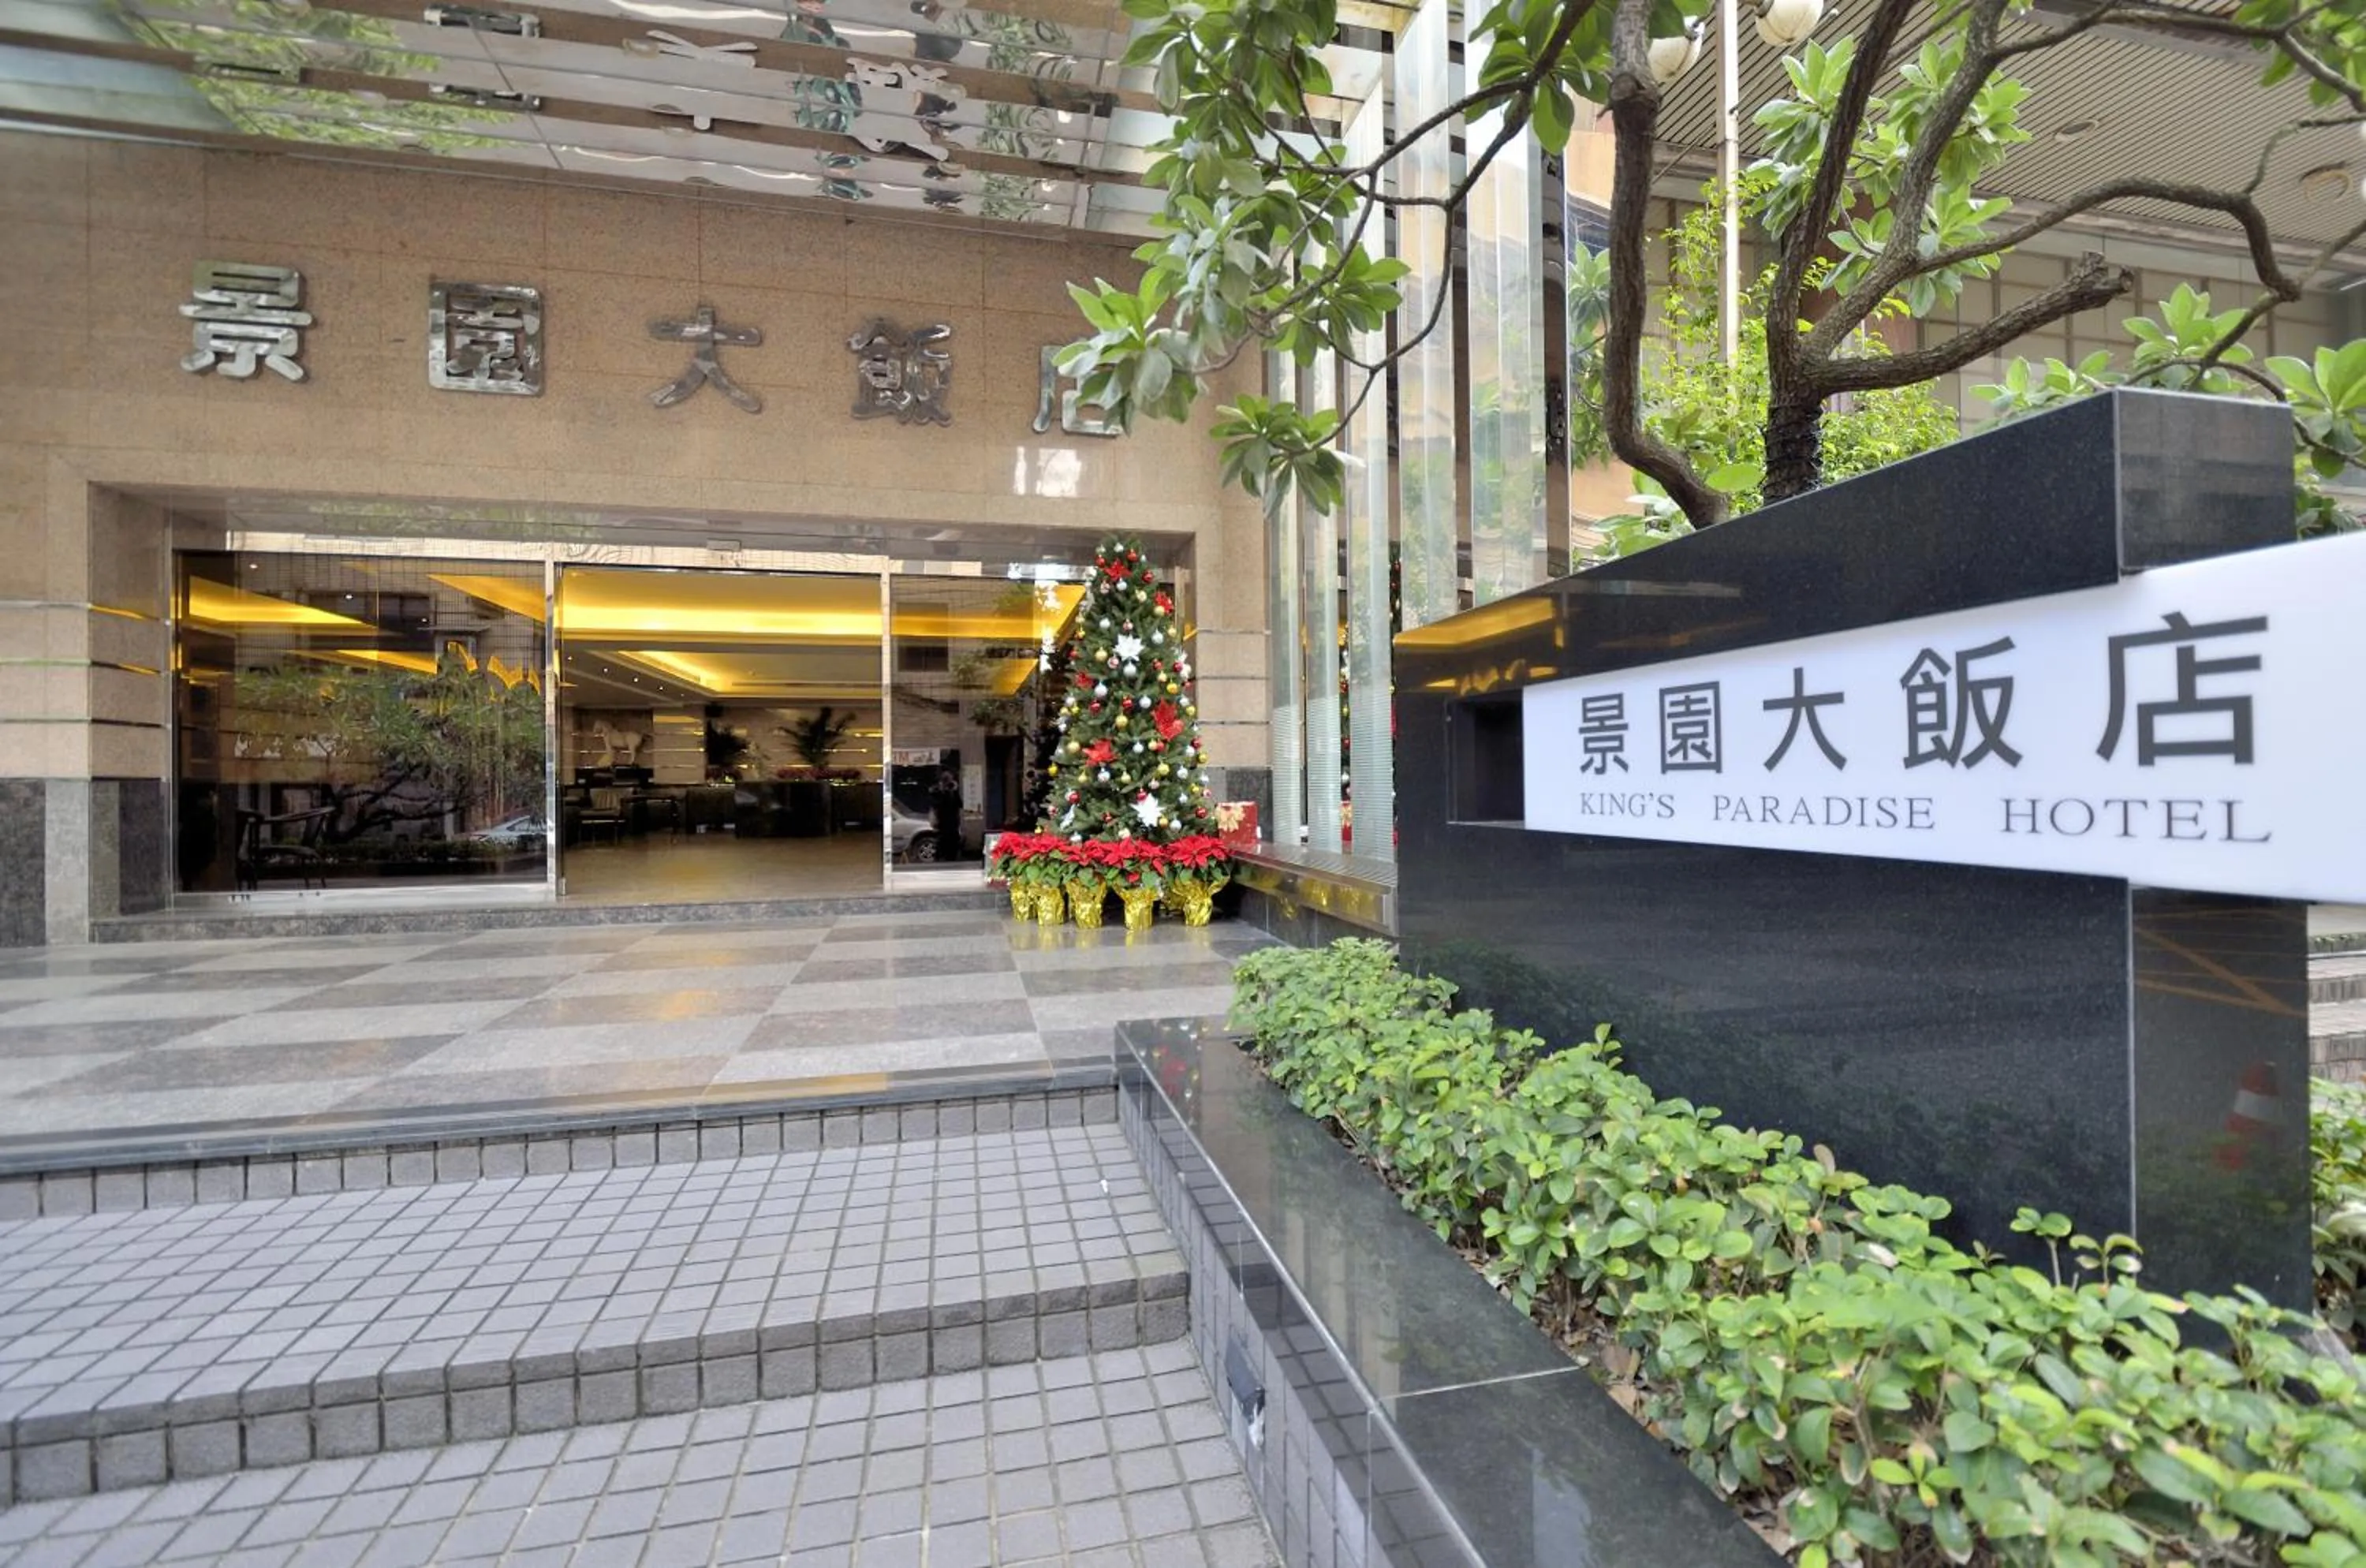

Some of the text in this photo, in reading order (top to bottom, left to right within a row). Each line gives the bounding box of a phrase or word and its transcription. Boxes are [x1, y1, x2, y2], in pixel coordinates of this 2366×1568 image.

[1578, 611, 2269, 775] 景園大飯店
[1580, 792, 2272, 843] KING'S PARADISE HOTEL
